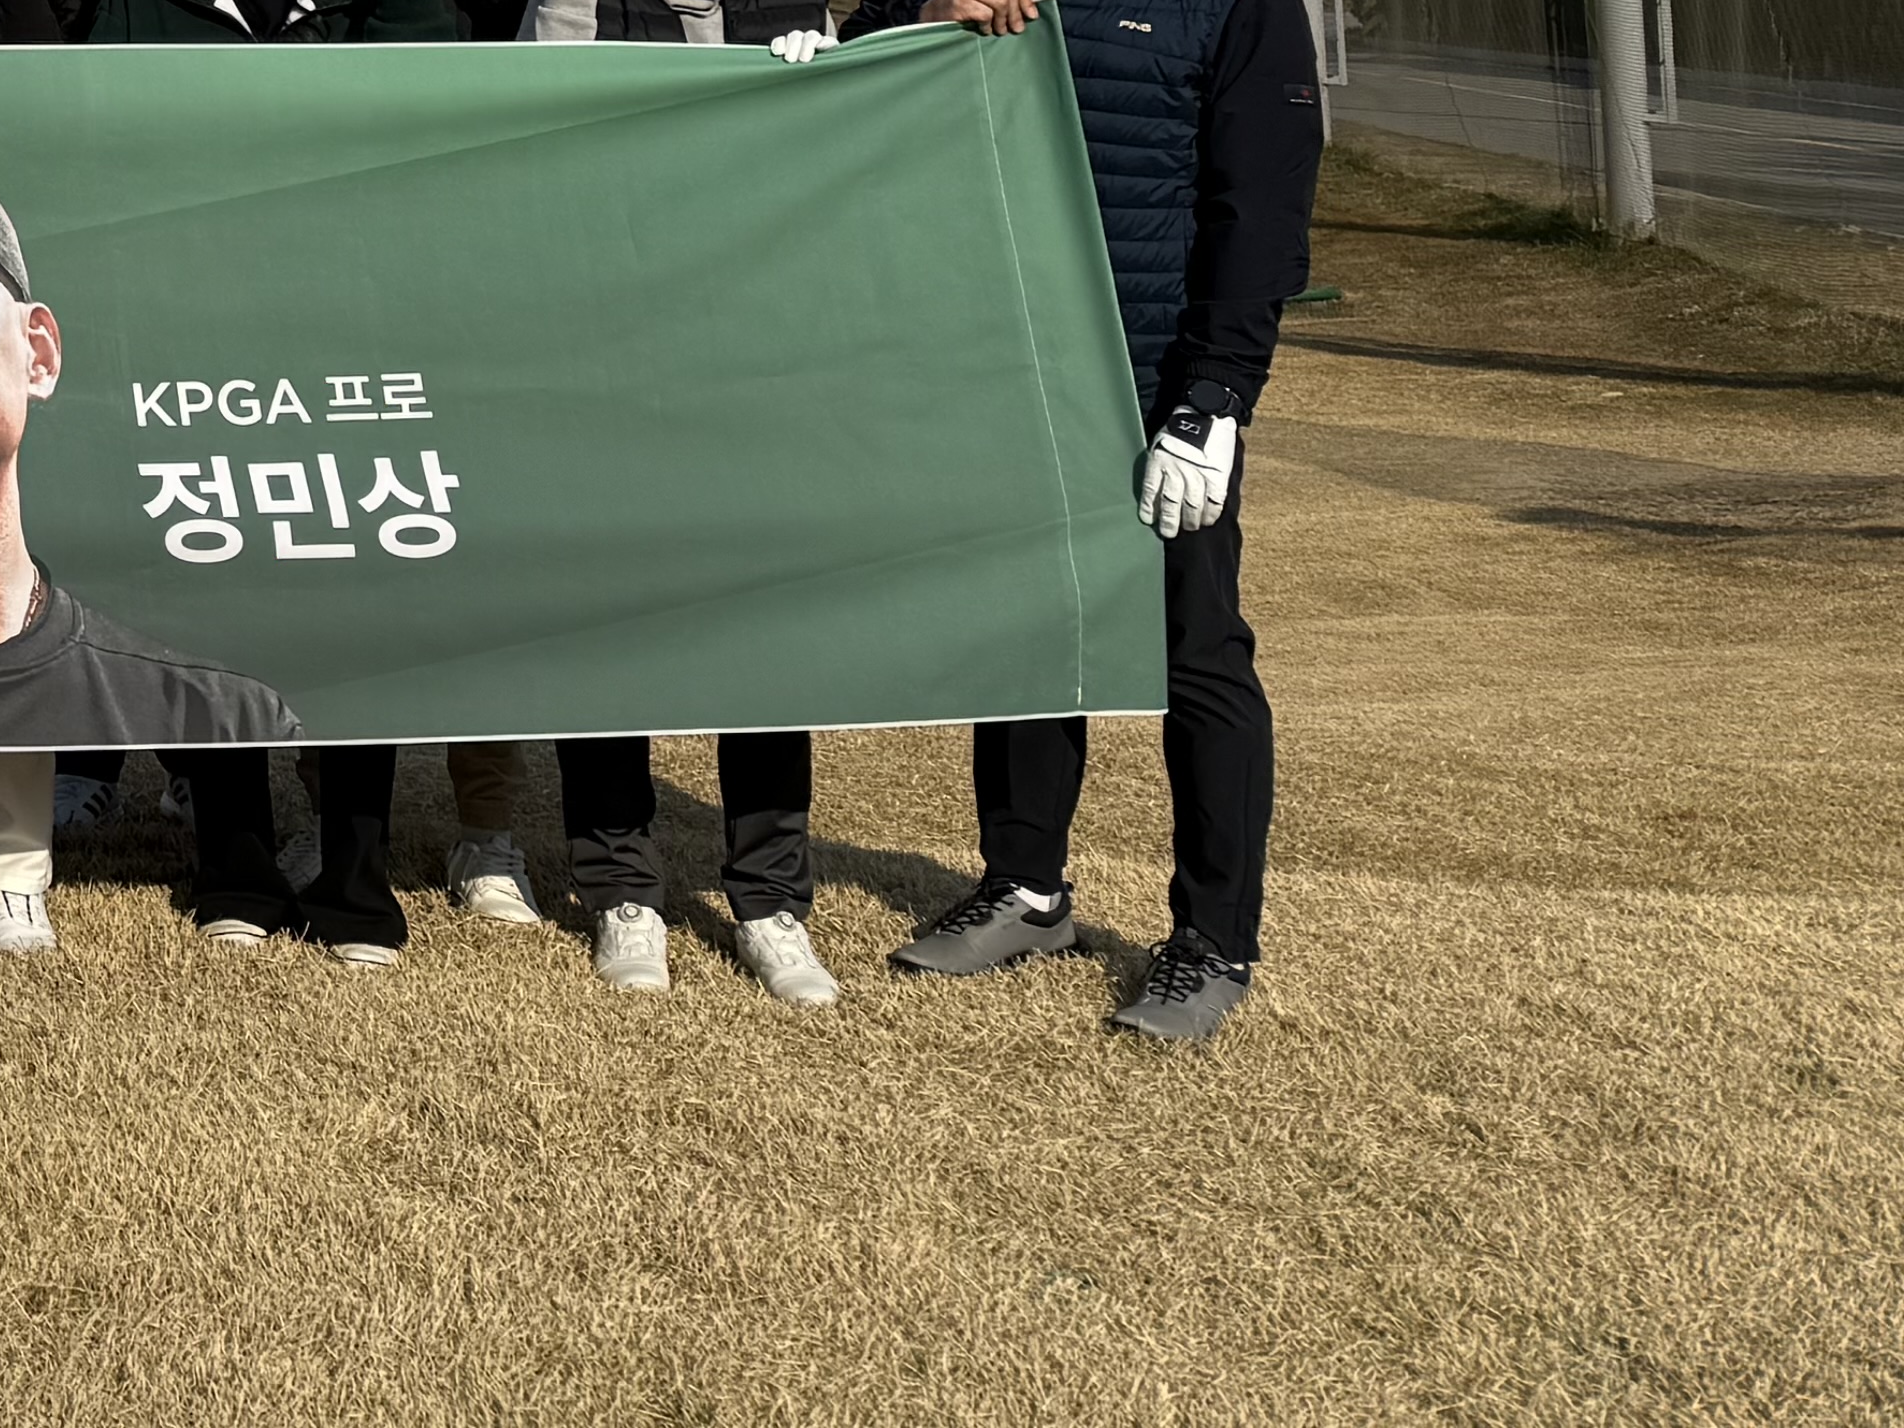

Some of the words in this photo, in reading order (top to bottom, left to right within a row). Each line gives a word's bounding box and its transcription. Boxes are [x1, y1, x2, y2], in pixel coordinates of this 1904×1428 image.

[132, 378, 312, 427] KPGA
[324, 372, 434, 422] 프로
[137, 450, 460, 563] 정민상
